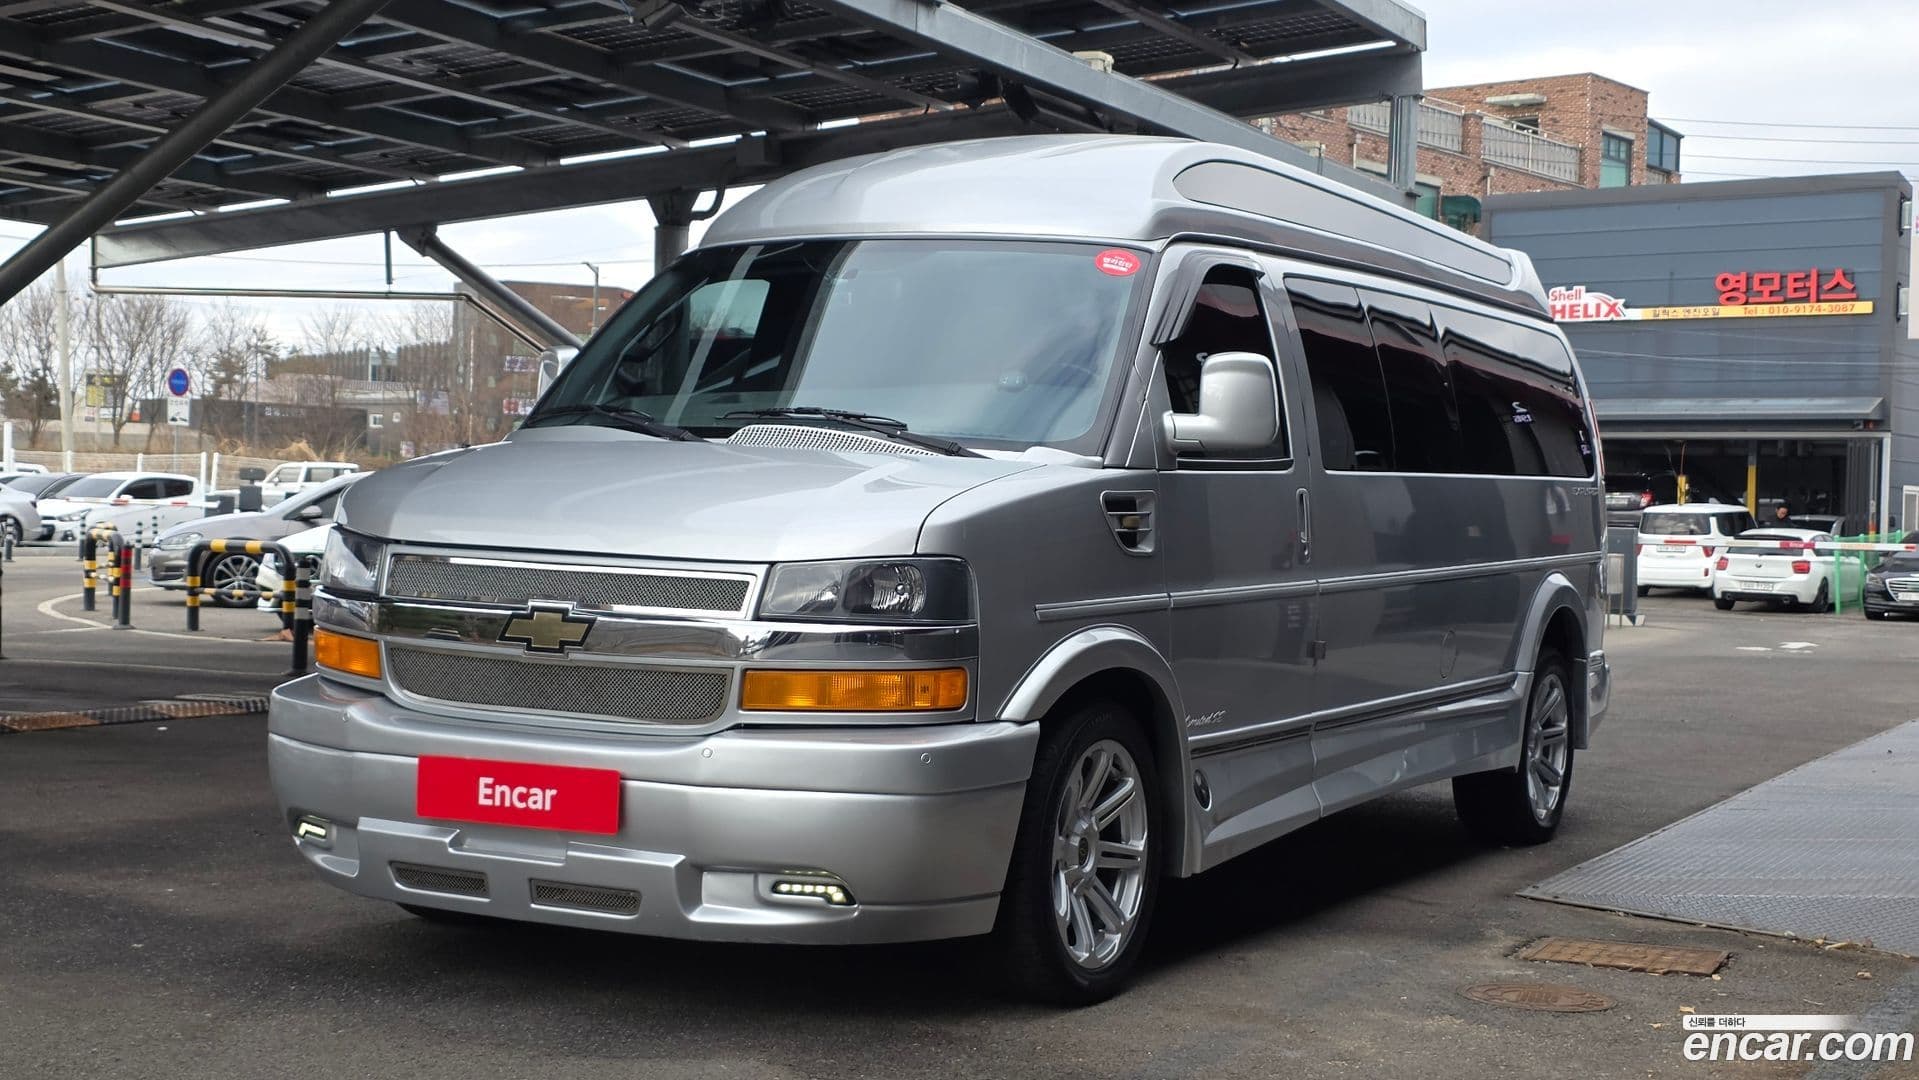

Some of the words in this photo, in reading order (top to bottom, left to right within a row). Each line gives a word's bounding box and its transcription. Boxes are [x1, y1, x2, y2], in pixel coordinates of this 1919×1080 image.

[1715, 266, 1857, 305] 영모터스
[1550, 288, 1582, 301] Shell
[1550, 302, 1624, 319] HELIX
[1743, 306, 1758, 317] Tel
[478, 776, 557, 811] Encar
